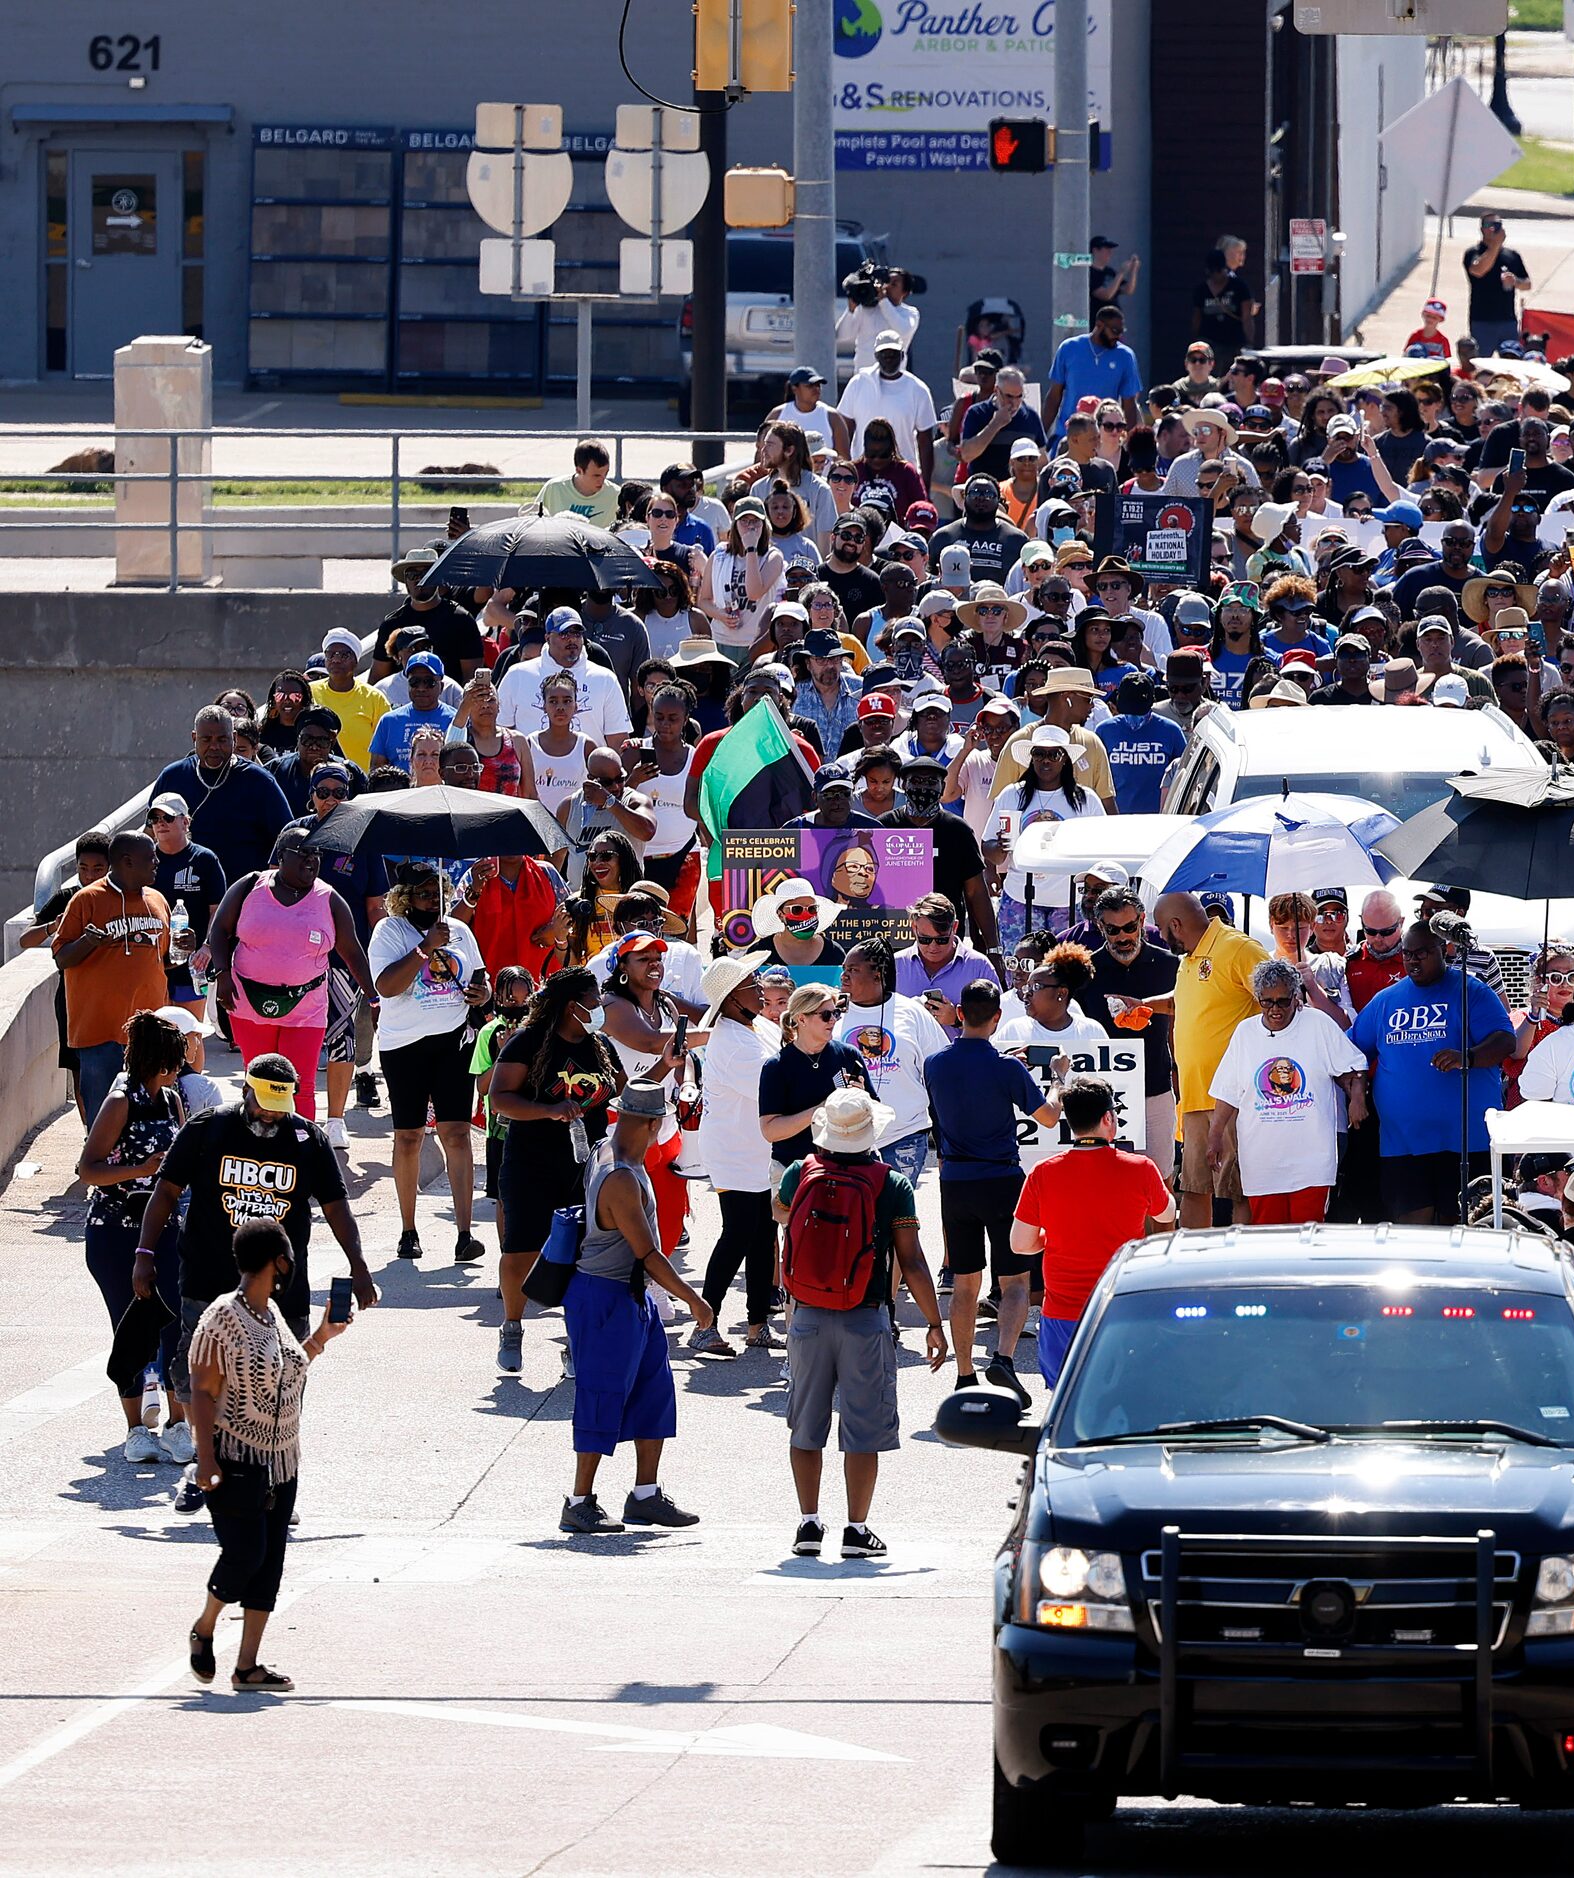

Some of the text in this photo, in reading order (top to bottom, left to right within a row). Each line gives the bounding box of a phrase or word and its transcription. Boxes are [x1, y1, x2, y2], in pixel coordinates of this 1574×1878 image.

[891, 0, 1019, 36] Panther
[913, 38, 974, 53] ARBOR
[987, 38, 997, 53] &
[88, 35, 161, 71] 621
[260, 128, 349, 145] BELGARD
[891, 134, 925, 149] Pool
[929, 134, 956, 149] and
[866, 151, 918, 167] Pavers
[570, 504, 596, 517] NIKE
[972, 540, 1003, 552] AACE
[1155, 541, 1185, 550] NATIONAL
[1151, 550, 1176, 560] HOLIDAY
[1112, 742, 1163, 752] JUST
[1109, 752, 1165, 765] GRIND
[726, 847, 796, 858] FREEDOM
[106, 919, 128, 939] TEXAS
[842, 919, 859, 928] THE
[881, 919, 896, 928] OF
[830, 930, 852, 940] THE
[874, 930, 892, 940] OF
[1400, 1031, 1421, 1042] BETA
[1422, 1029, 1447, 1040] SIGMA
[223, 1160, 294, 1191] HBCU
[241, 1189, 273, 1204] IT'S A
[227, 1194, 288, 1217] DIFFERENT
